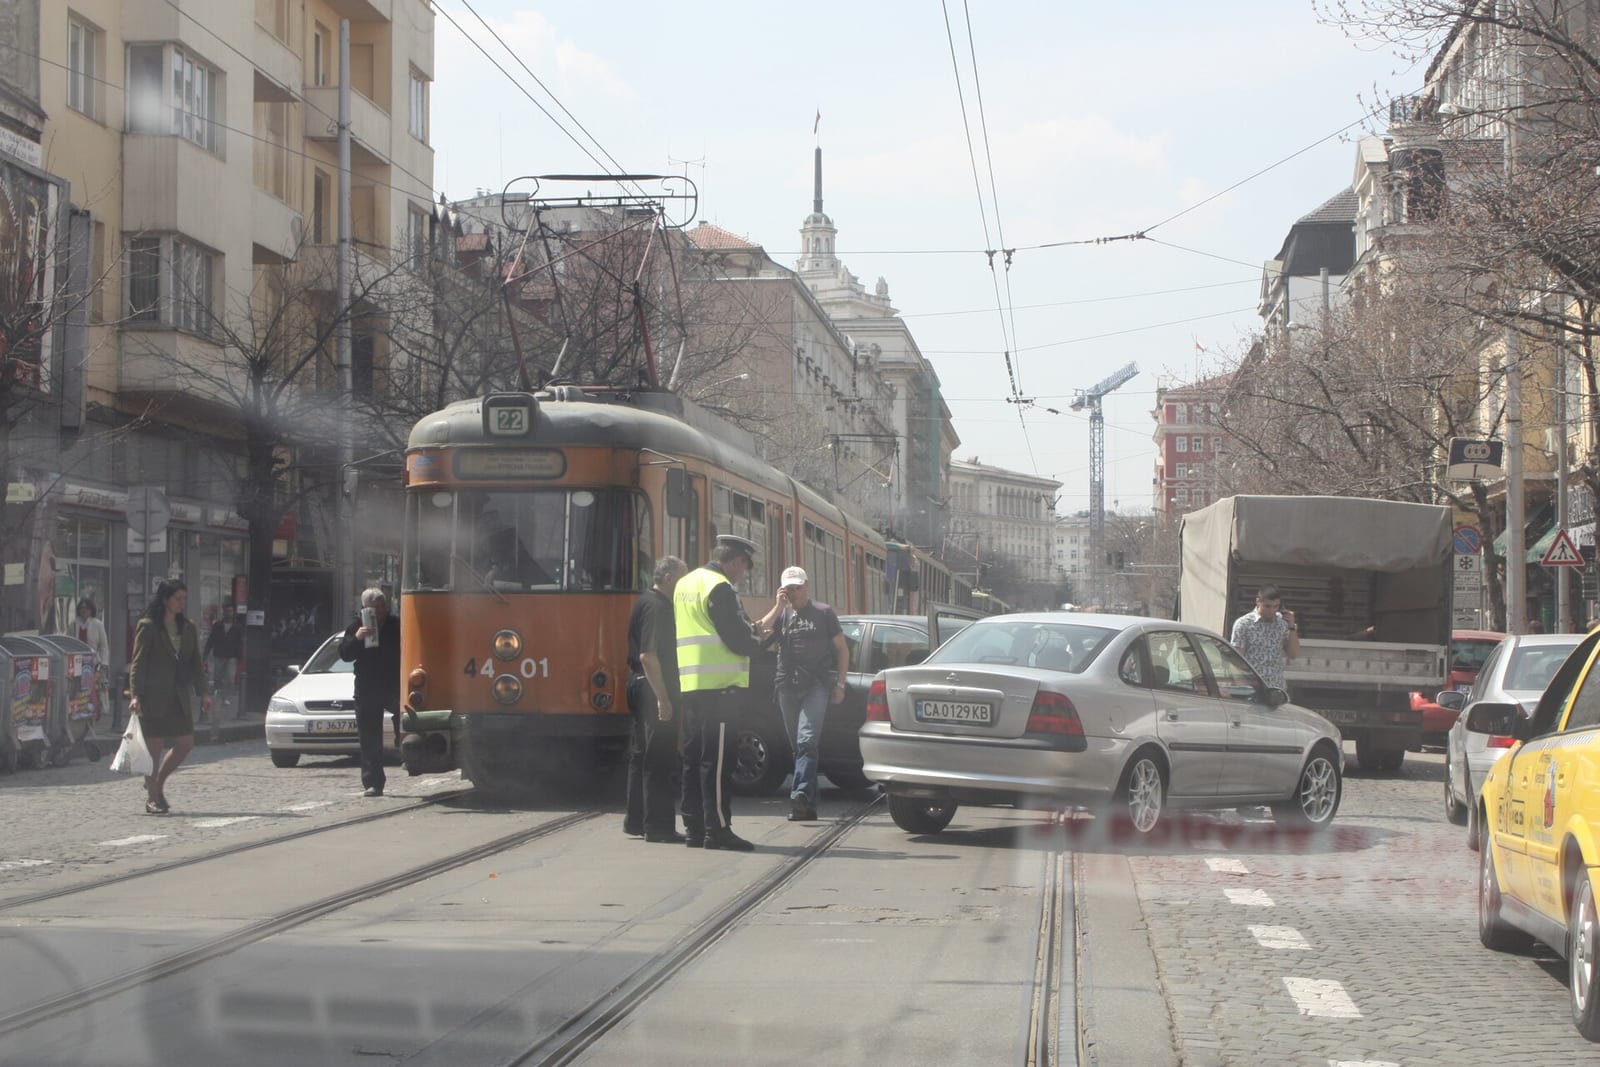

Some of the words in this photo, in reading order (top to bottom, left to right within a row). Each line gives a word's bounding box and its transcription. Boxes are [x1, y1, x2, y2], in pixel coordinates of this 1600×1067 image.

[499, 411, 522, 429] 22
[463, 657, 495, 678] 44
[520, 657, 549, 678] 01
